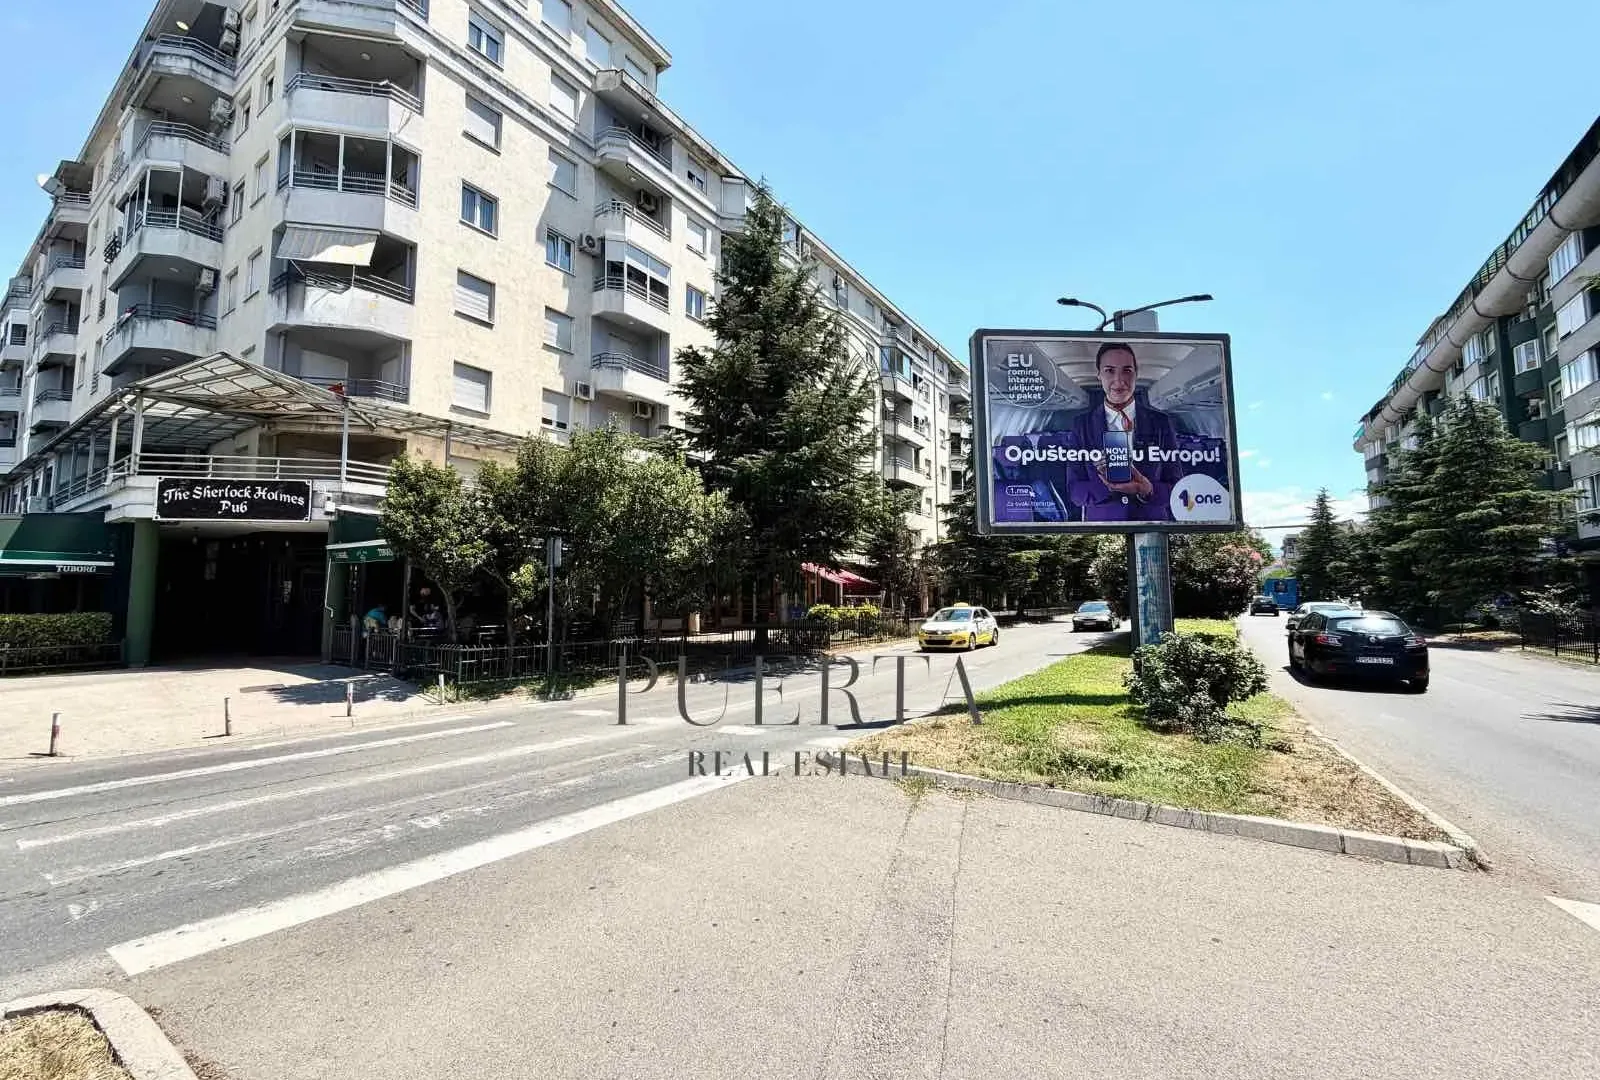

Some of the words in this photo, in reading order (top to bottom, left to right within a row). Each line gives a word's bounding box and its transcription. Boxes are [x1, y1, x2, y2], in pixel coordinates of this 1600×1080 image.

[1008, 354, 1033, 368] EU
[1008, 368, 1040, 377] roming
[1008, 376, 1044, 384] internet
[1017, 392, 1042, 401] paket
[1005, 445, 1102, 465] Opušteno
[1132, 449, 1144, 461] u
[1148, 446, 1220, 466] Evropu!
[163, 488, 190, 503] The
[192, 485, 251, 499] Sherlock
[253, 486, 305, 506] Holmes
[1195, 494, 1222, 504] one
[218, 500, 248, 514] Pub
[56, 565, 97, 573] TUBORG
